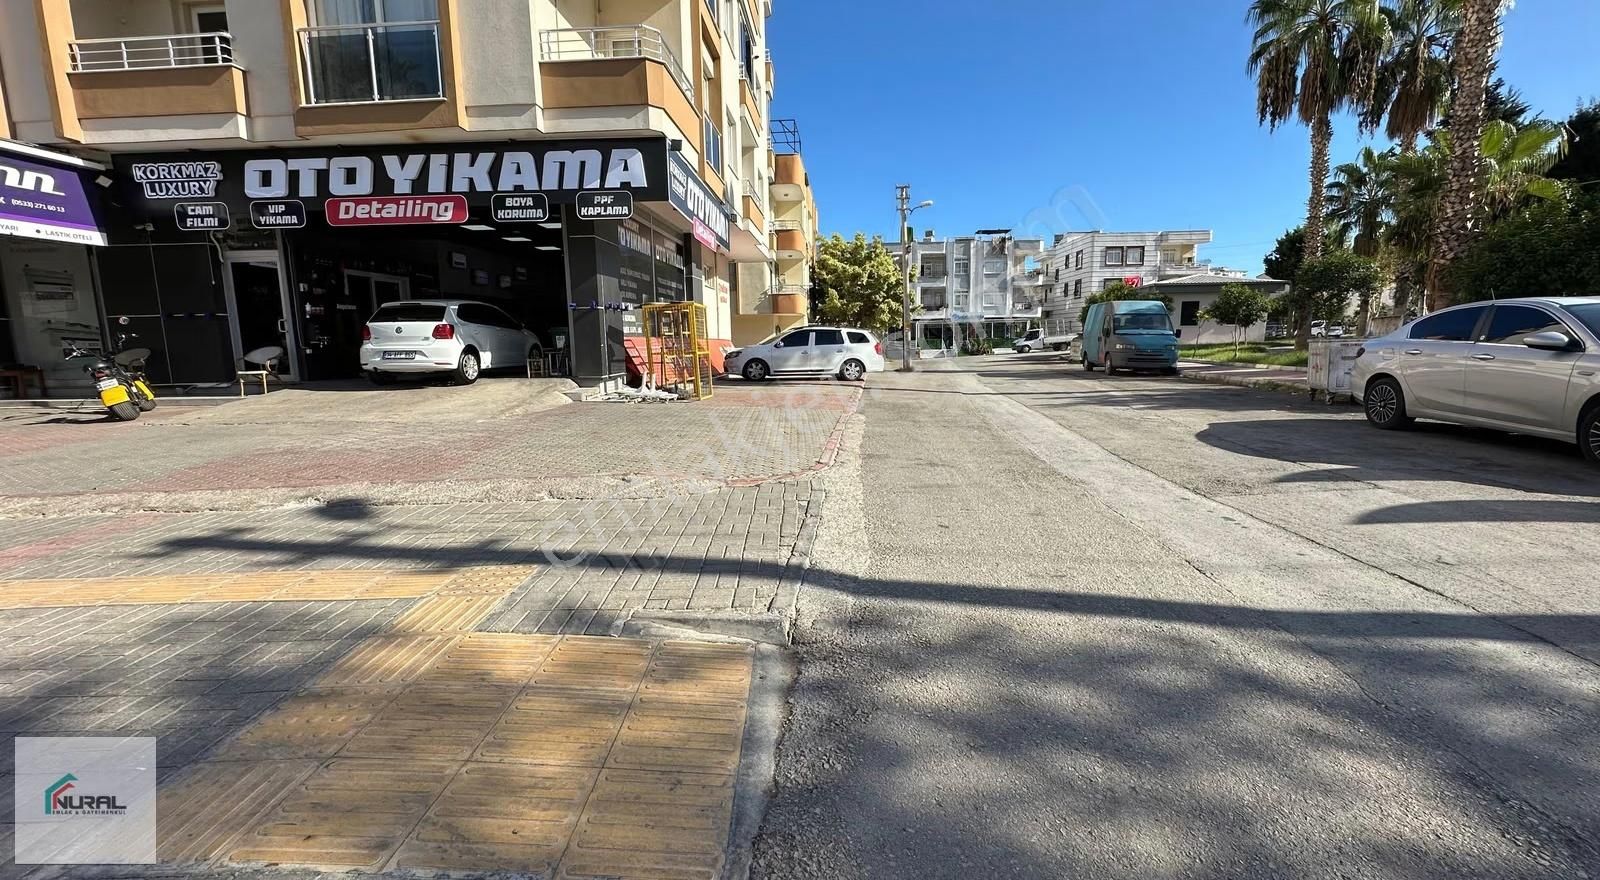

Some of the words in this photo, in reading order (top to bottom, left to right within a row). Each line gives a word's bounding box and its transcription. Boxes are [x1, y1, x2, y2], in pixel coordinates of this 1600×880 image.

[133, 162, 219, 182] KORKMAZ
[244, 156, 374, 198] OTO
[143, 180, 212, 198] LUXURY
[505, 197, 534, 207] BOYA
[594, 195, 615, 204] PPF
[187, 205, 214, 216] CAM
[267, 204, 286, 214] VIP
[338, 199, 455, 221] Detailing
[497, 208, 544, 219] KORUMA
[580, 206, 629, 216] KAPLAMA
[259, 215, 299, 225] YIKAMA
